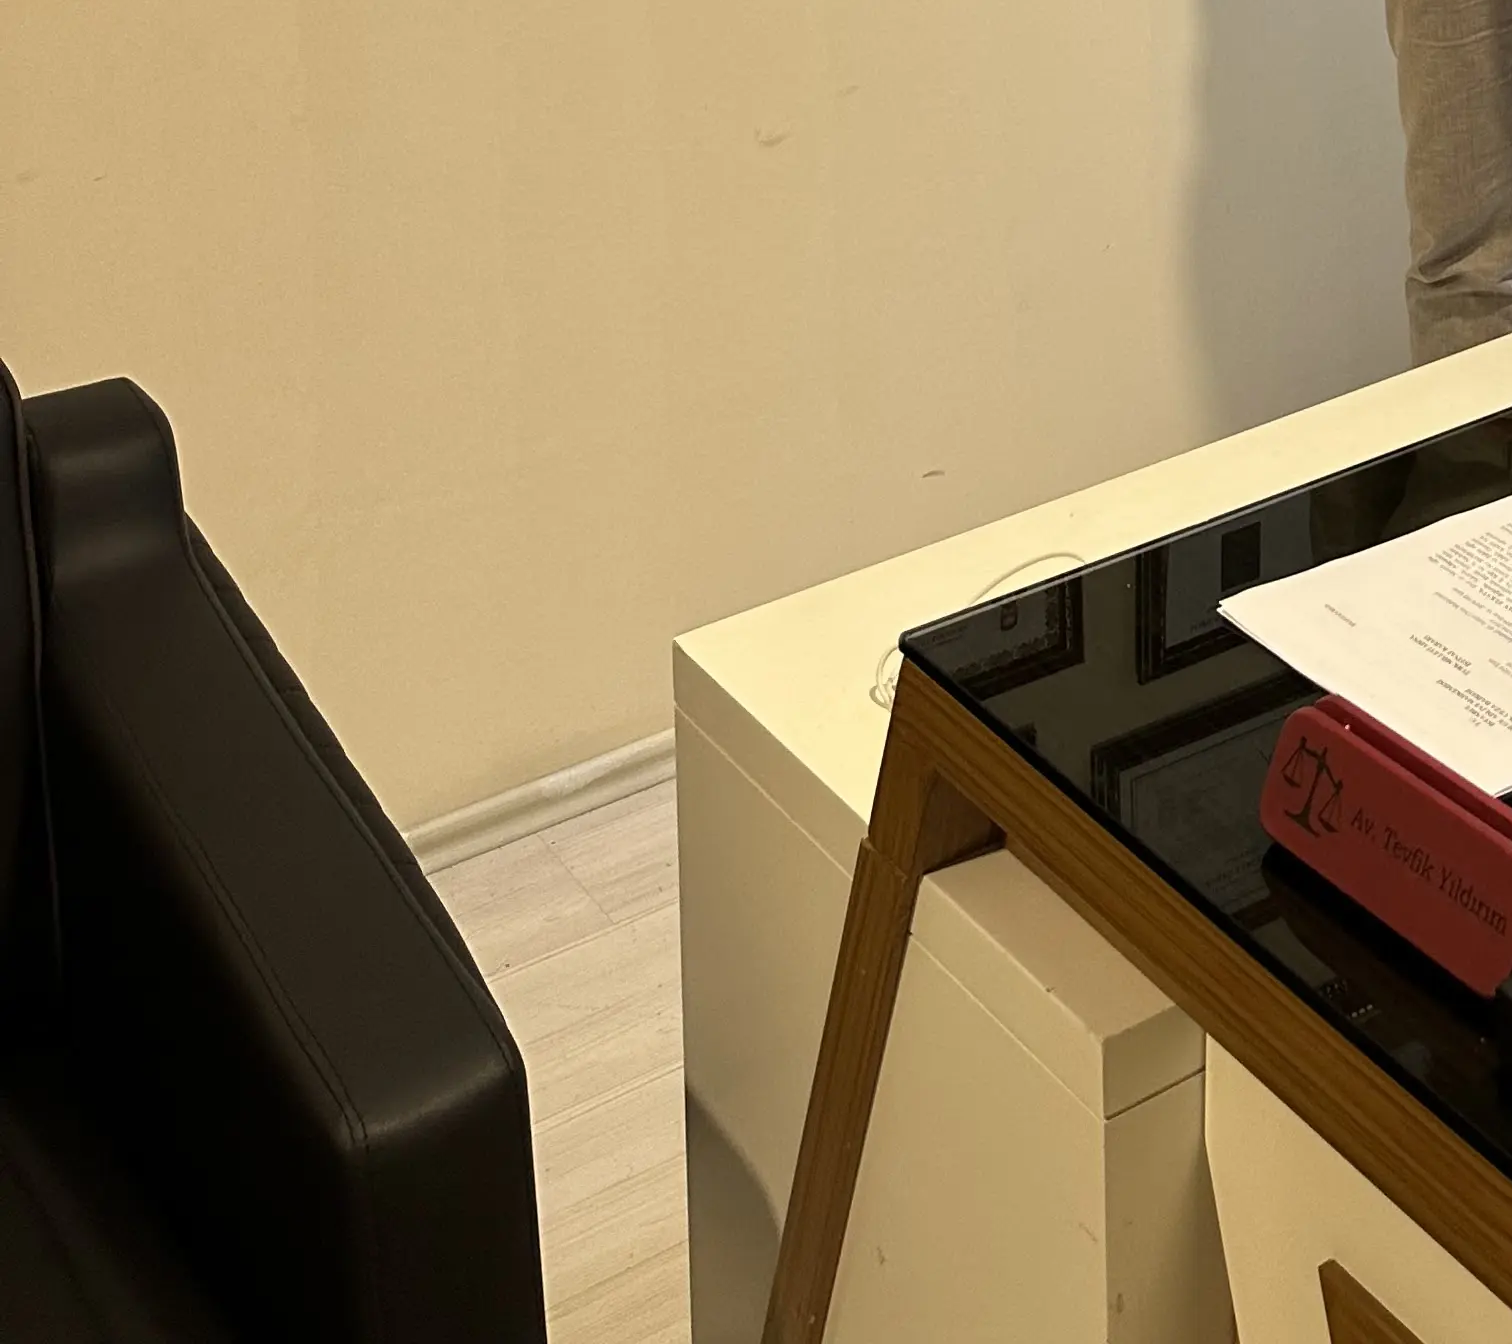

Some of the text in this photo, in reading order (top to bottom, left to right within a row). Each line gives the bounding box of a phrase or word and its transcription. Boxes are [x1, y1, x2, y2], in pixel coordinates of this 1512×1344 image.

[1350, 808, 1509, 937] Av. Tevfik Yıldırım
